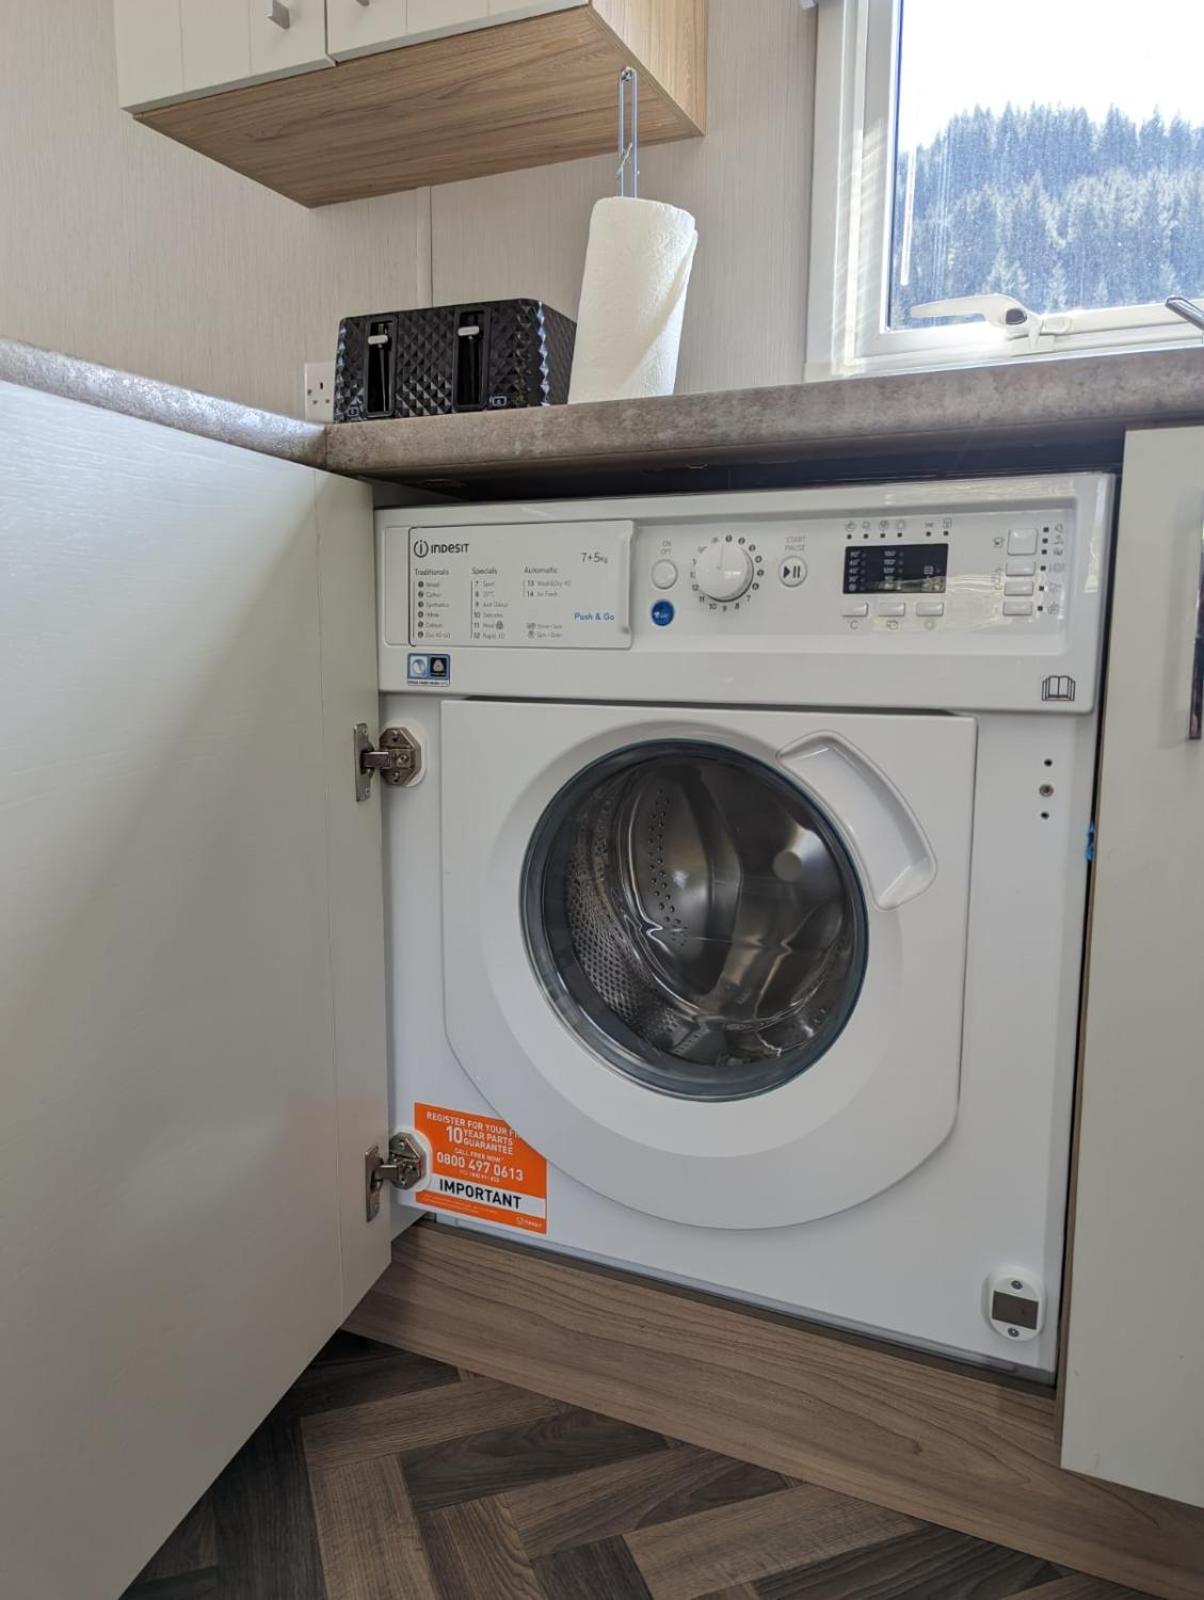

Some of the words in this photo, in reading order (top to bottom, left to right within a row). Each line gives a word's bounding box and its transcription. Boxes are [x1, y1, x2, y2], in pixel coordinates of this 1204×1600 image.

[574, 612, 593, 621] Push
[595, 612, 602, 621] &
[603, 612, 615, 621] Go
[426, 1111, 466, 1127] REGISTER
[467, 1119, 484, 1132] FOR
[486, 1123, 508, 1136] YOUR
[446, 1125, 463, 1144] 10
[463, 1128, 485, 1139] YEAR
[486, 1133, 513, 1146] PARTS
[463, 1137, 513, 1155] GUARANTEE
[436, 1151, 465, 1168] 0800
[468, 1159, 490, 1175] 497
[493, 1164, 524, 1181] 0613
[439, 1178, 523, 1209] IMPORTANT
